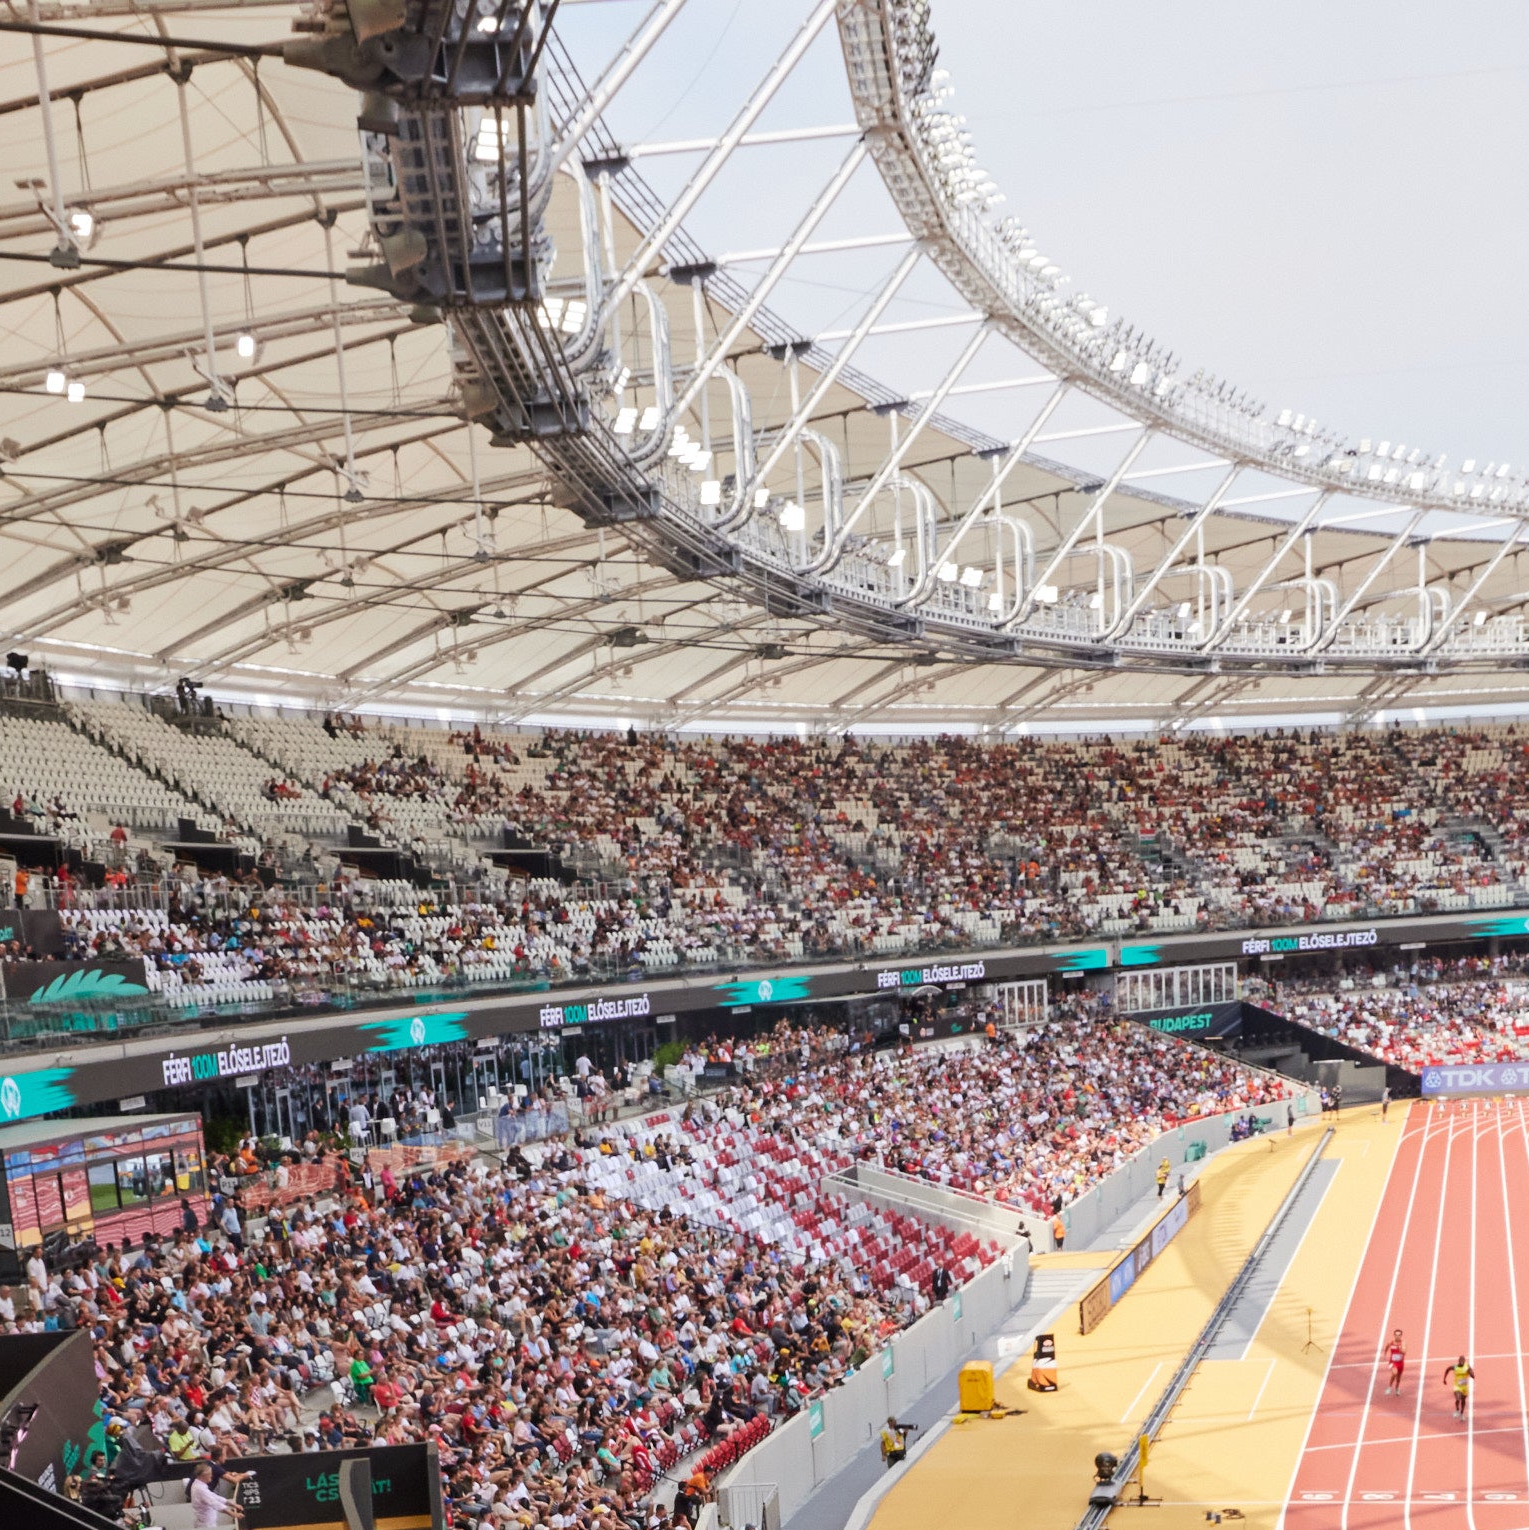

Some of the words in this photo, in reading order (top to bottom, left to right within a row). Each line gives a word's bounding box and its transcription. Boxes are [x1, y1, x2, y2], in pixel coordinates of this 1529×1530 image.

[1242, 938, 1270, 955] FÉRFI
[1271, 937, 1298, 952] 100M
[878, 969, 900, 988] FÉRFI
[901, 970, 922, 985] 100M
[540, 1004, 563, 1027] FÉRFI
[564, 1005, 587, 1024] 100M
[162, 1053, 192, 1085] FÉRFI
[191, 1053, 219, 1080] 100M
[1441, 1069, 1495, 1088] TDK
